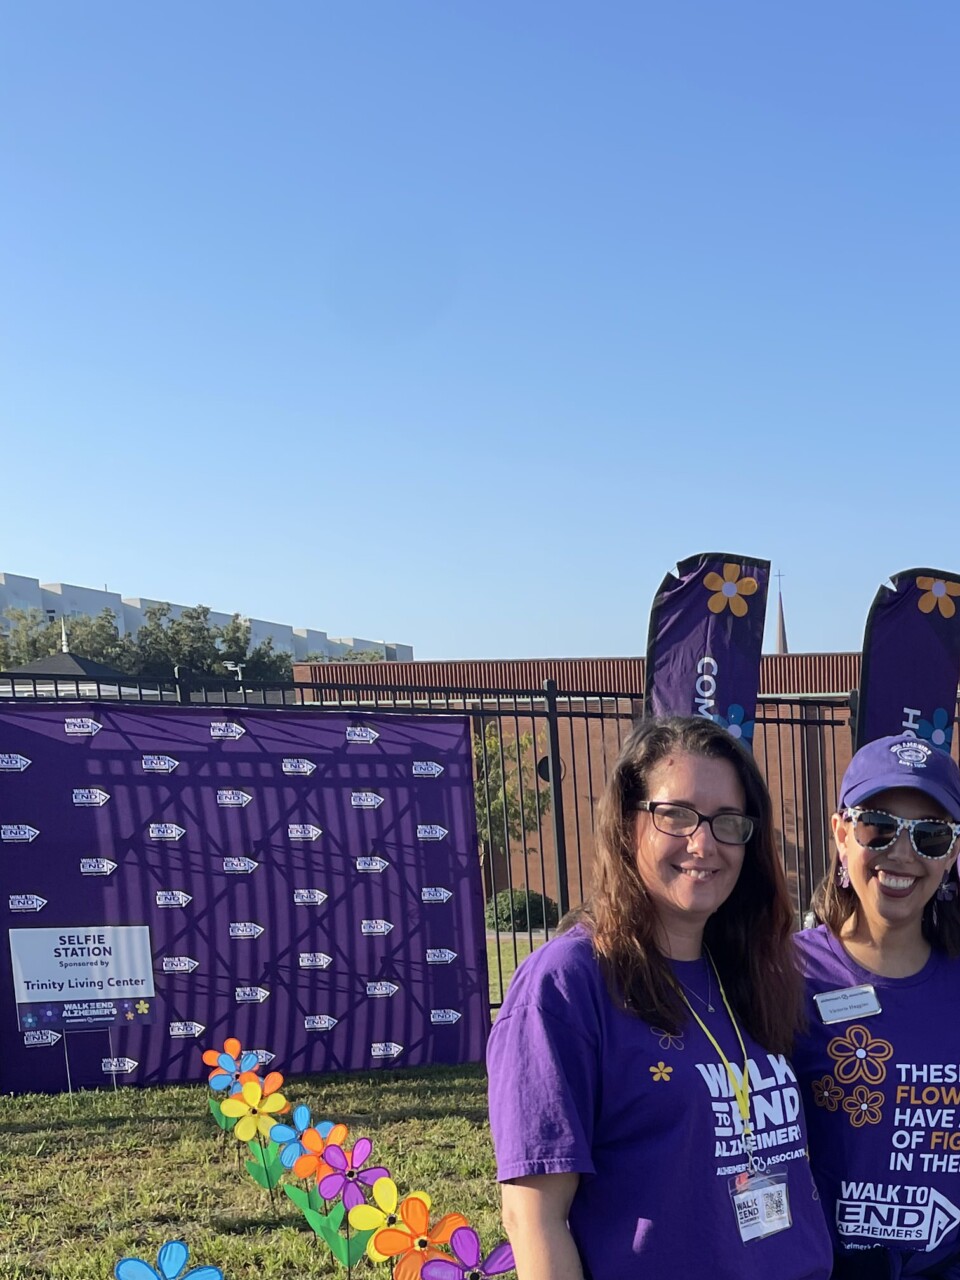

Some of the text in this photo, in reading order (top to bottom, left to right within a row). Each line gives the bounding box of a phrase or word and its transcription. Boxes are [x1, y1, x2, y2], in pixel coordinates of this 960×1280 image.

[59, 935, 105, 946] SELFIE
[54, 946, 112, 958] STATION
[59, 961, 98, 969] Sponsored
[24, 977, 146, 992] Trinity Living Center
[62, 1008, 117, 1017] ALZHEIMER'S
[64, 1003, 89, 1011] WALK
[695, 1054, 797, 1098] WALK
[716, 1087, 799, 1135] TO END
[894, 1108, 956, 1128] HAVE
[715, 1124, 802, 1157] ALZHEIMER
[892, 1130, 925, 1149] OF
[890, 1152, 914, 1171] IN
[841, 1181, 928, 1204] WALK TO
[737, 1199, 758, 1211] WALK
[743, 1208, 759, 1218] END
[839, 1202, 925, 1228] END
[838, 1223, 923, 1238] ALZHEIMER'S
